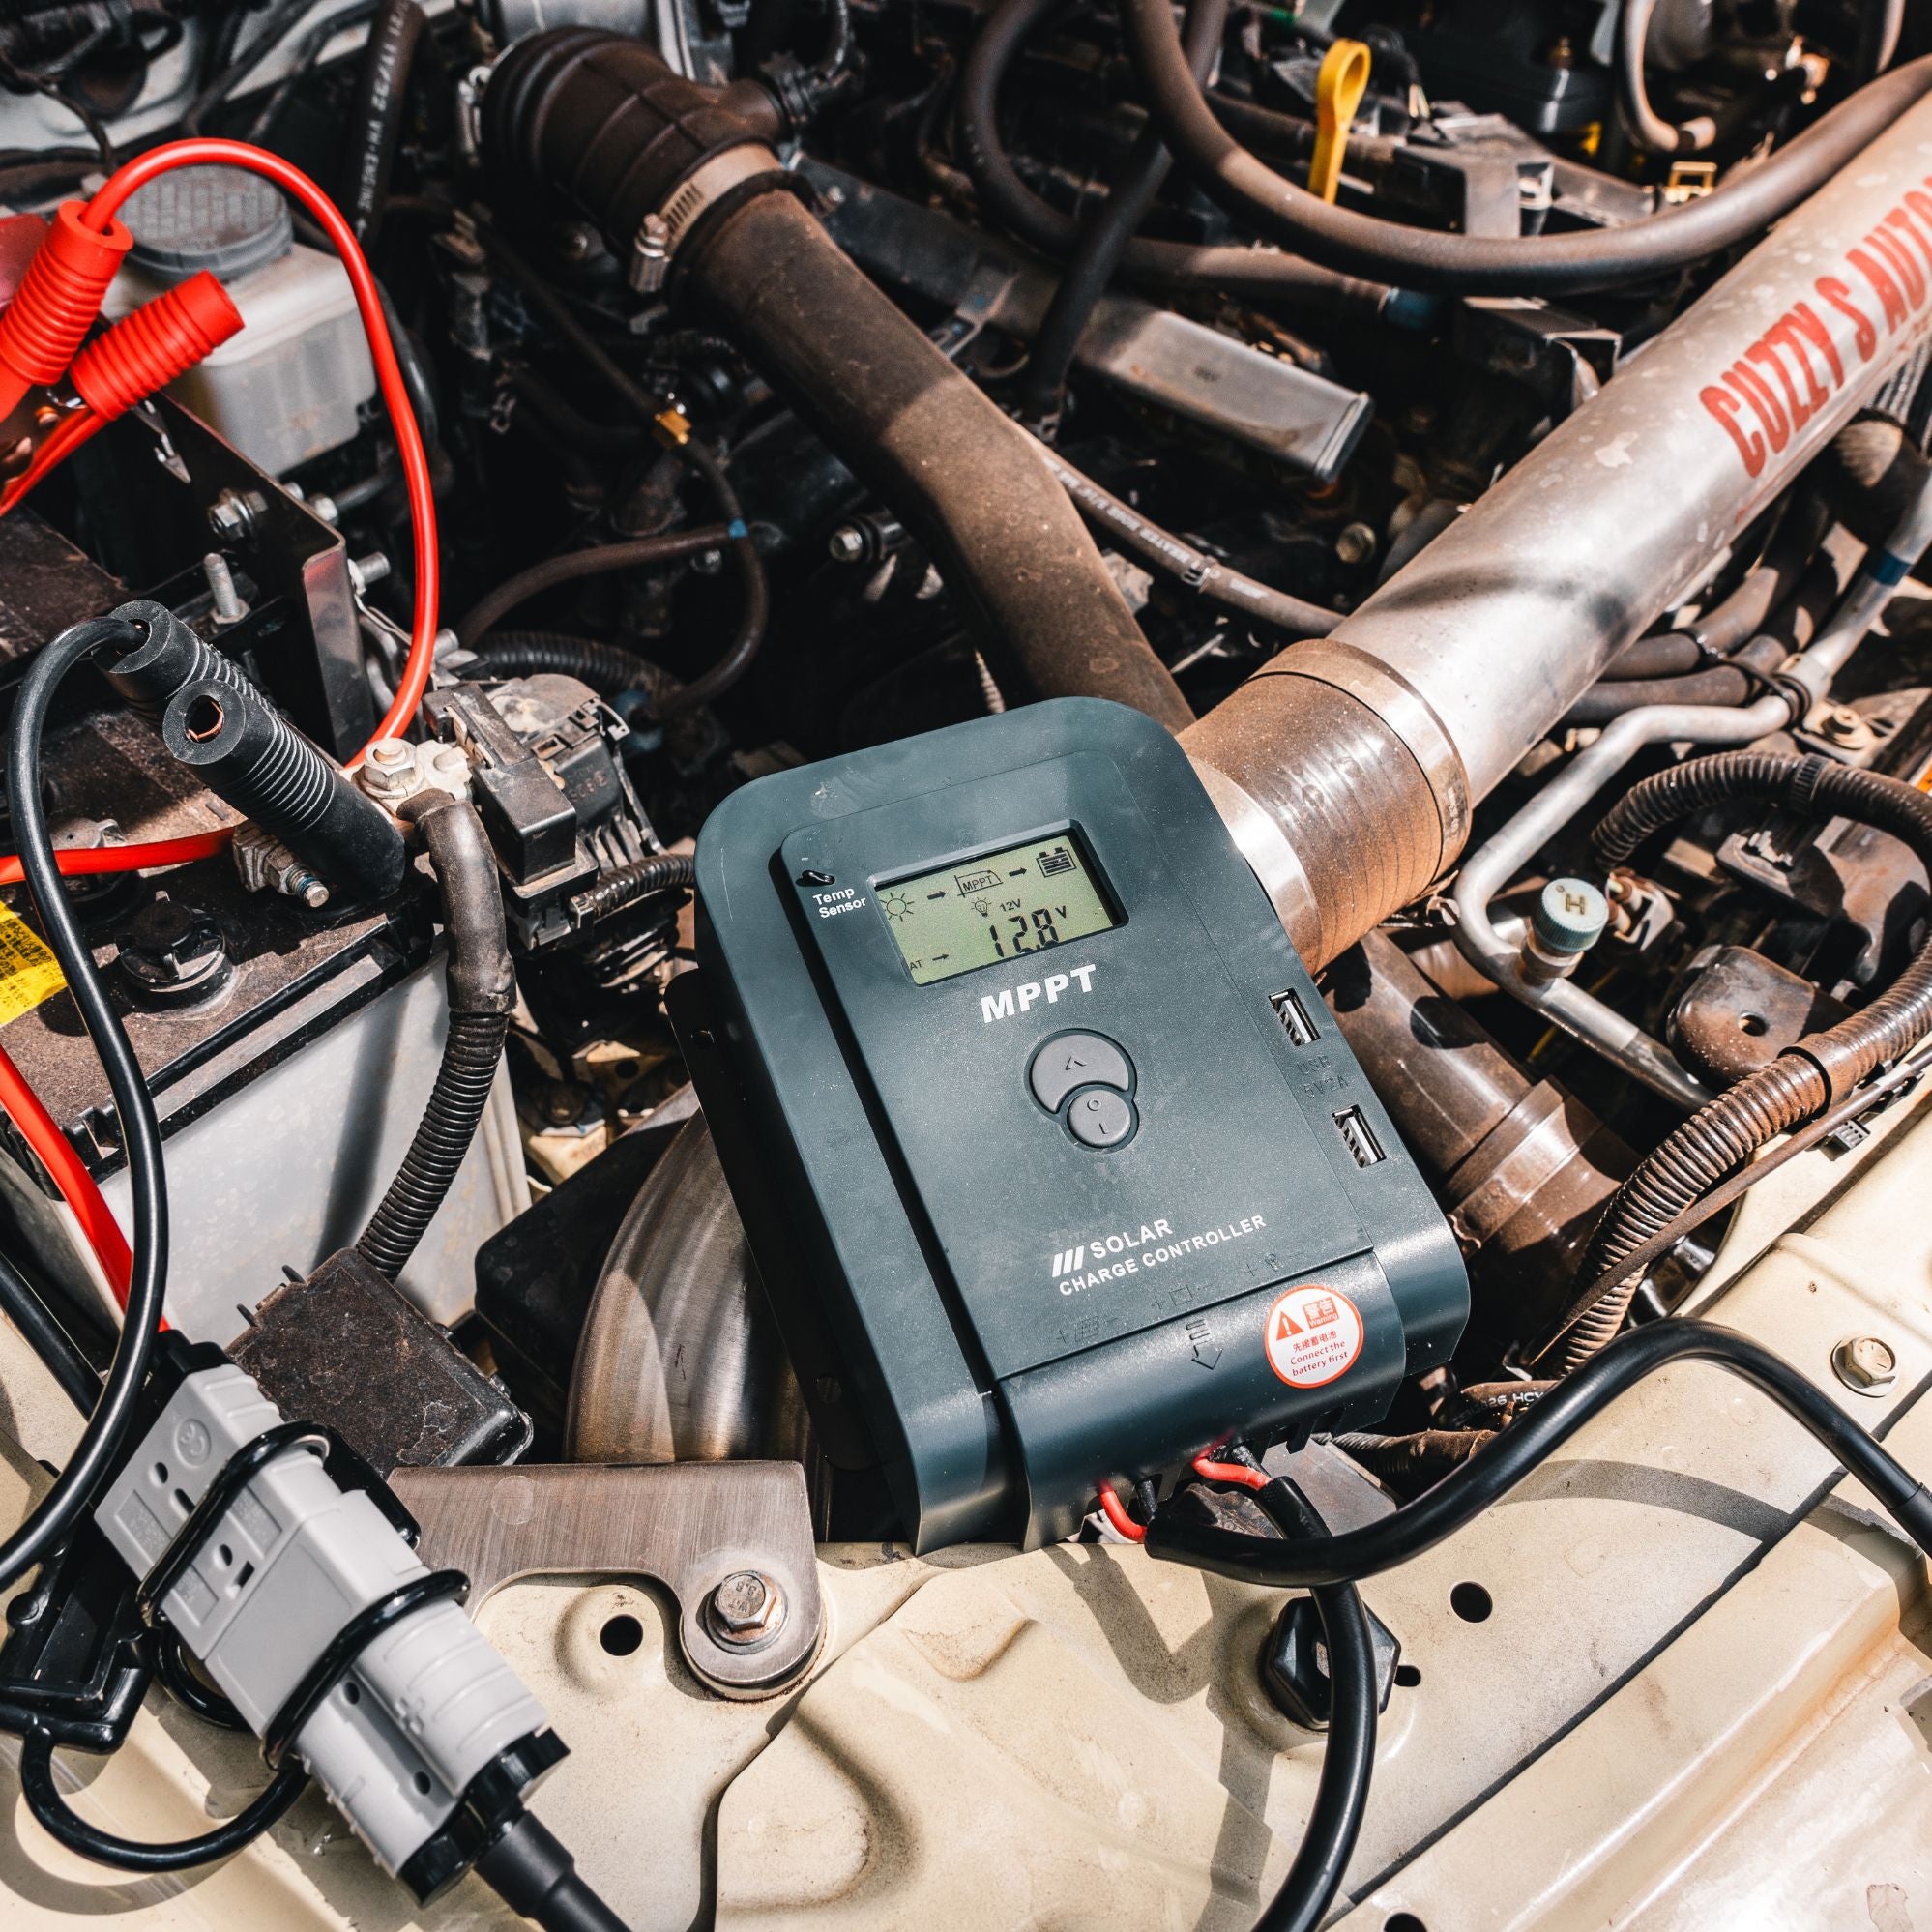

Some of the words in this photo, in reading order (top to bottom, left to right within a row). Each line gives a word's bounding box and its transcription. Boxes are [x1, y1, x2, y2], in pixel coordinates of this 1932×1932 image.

[1699, 302, 1845, 478] CUZZY
[1845, 176, 1932, 335] AUT
[962, 874, 994, 893] MPPT
[812, 887, 856, 907] Temp
[818, 896, 867, 919] Sensor
[999, 898, 1022, 913] 12V
[1565, 893, 1586, 916] H
[980, 963, 1097, 1024] MPPT
[1089, 1218, 1174, 1260] SOLAR
[1059, 1257, 1139, 1296] CHARGE
[1142, 1215, 1267, 1268] CONTROLLER
[1308, 1314, 1338, 1326] Warning
[1290, 1345, 1329, 1365] Connect
[1330, 1340, 1346, 1352] the
[1292, 1360, 1327, 1377] battery
[1328, 1351, 1348, 1363] first
